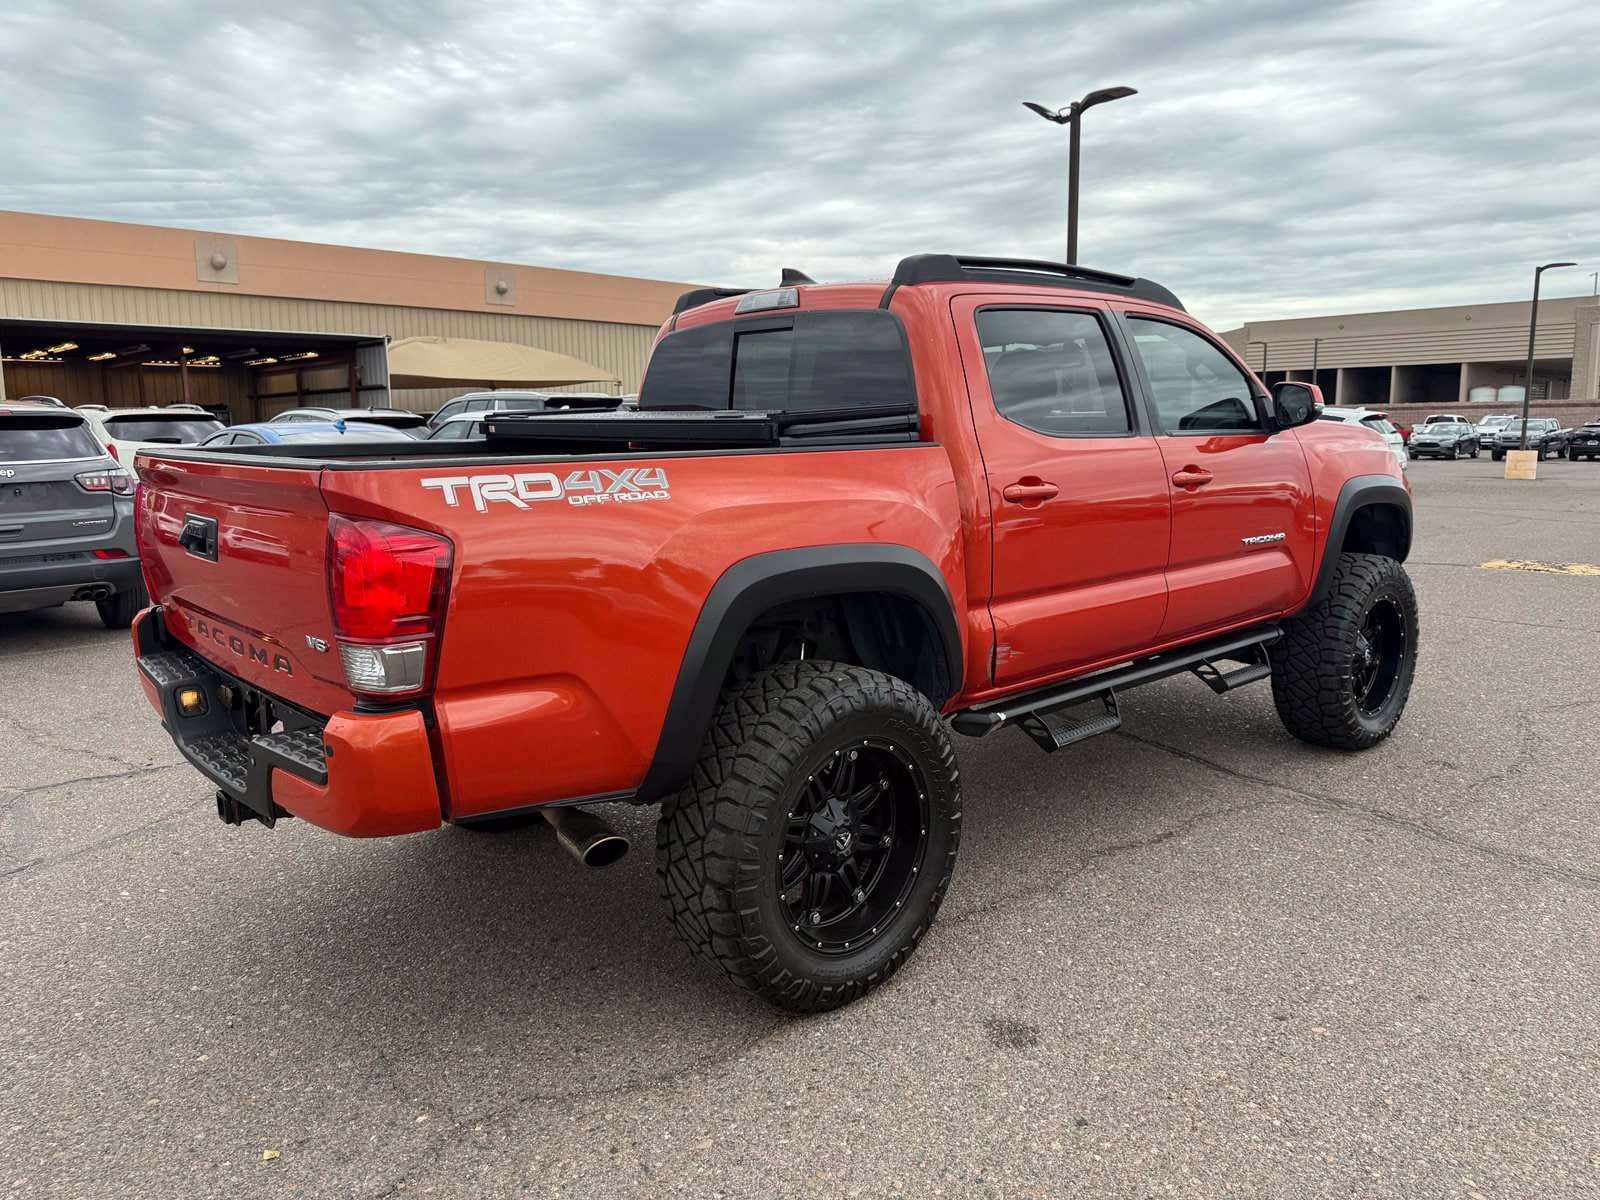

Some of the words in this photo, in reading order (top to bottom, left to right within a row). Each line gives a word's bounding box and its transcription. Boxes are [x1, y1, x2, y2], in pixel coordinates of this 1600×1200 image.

[421, 472, 565, 513] TRD
[568, 492, 611, 506] OFF
[613, 490, 671, 504] ROAD
[1241, 532, 1286, 545] TACOMA
[184, 612, 293, 678] TACOMA
[305, 634, 329, 653] V6
